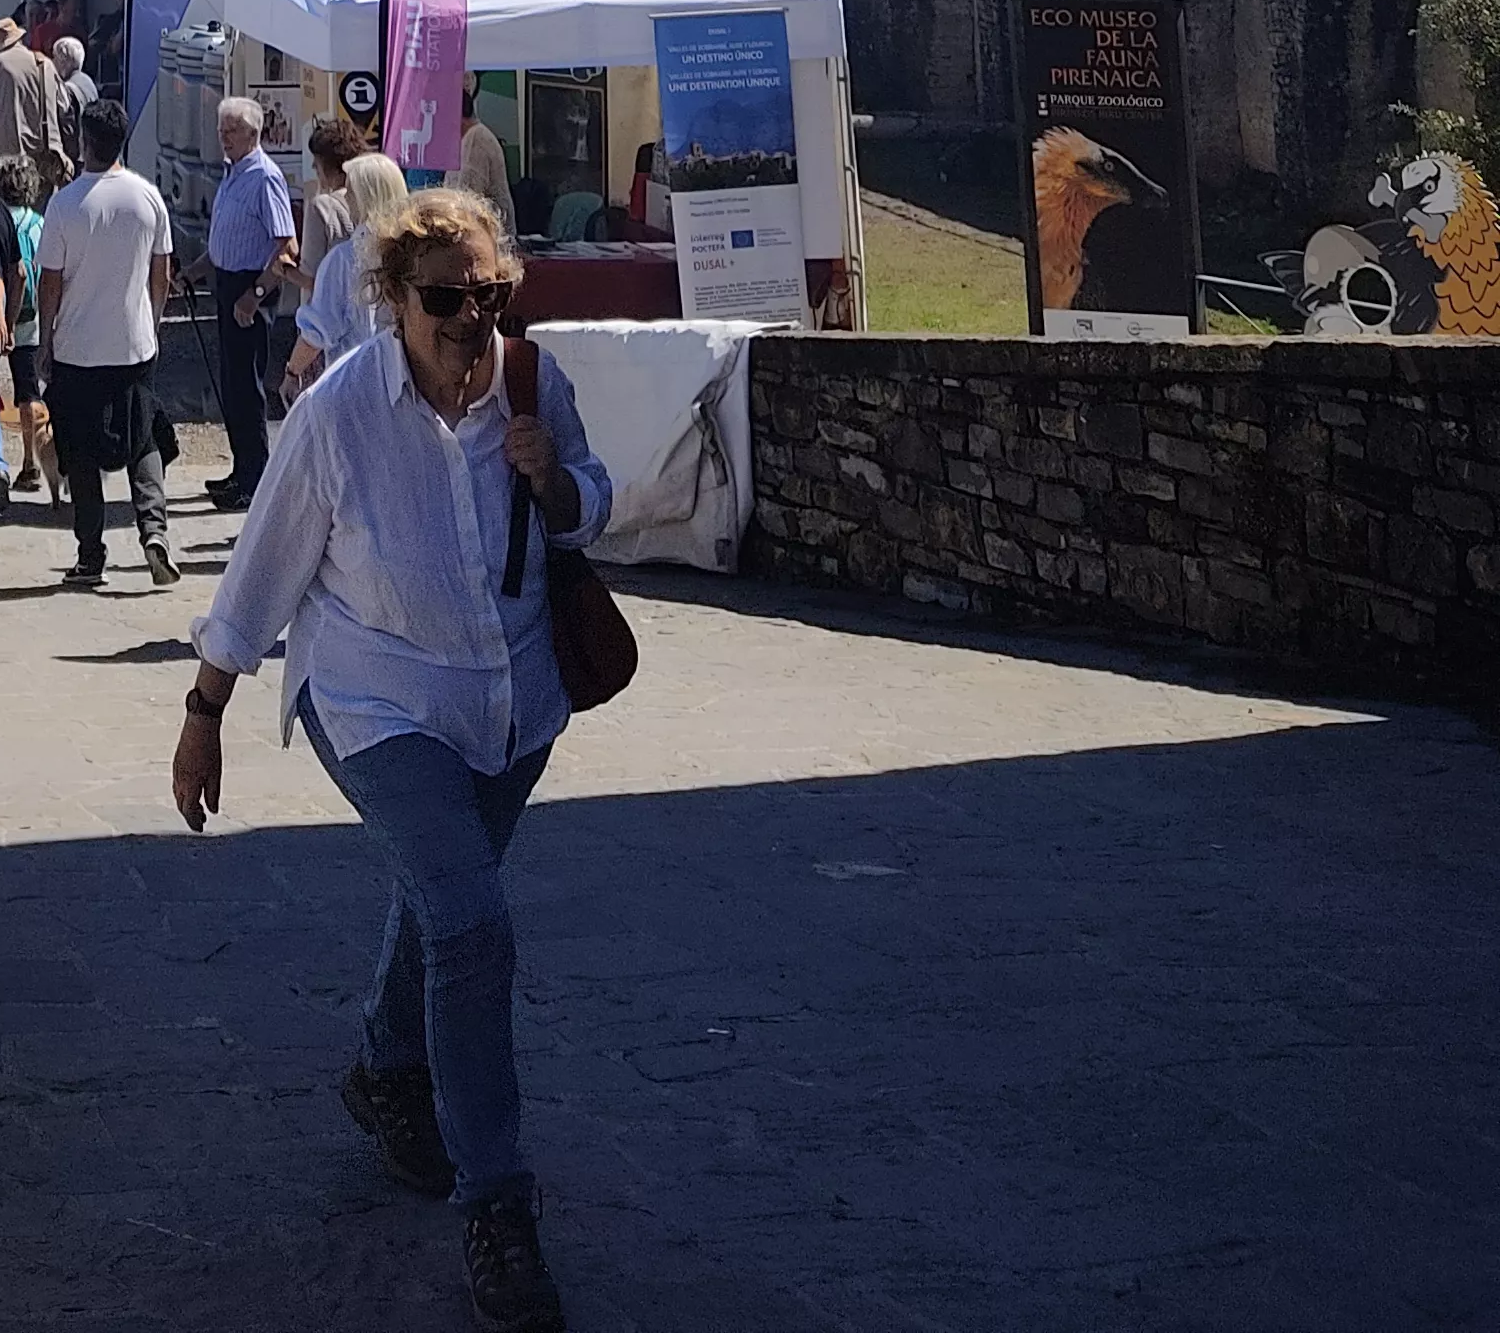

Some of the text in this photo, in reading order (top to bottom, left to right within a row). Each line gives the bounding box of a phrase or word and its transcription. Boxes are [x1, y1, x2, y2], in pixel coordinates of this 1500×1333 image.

[1030, 9, 1157, 28] ECO MUSEO
[426, 2, 441, 72] STATION
[1096, 30, 1158, 48] DE LA
[681, 50, 764, 64] UN DESTINO ÚNICO
[1086, 49, 1160, 68] FAUNA
[668, 77, 781, 93] UNE DESTINATION UNIQUE
[1051, 68, 1162, 88] PIRENAICA
[1050, 94, 1164, 107] PARQUE ZOOLÓGICO
[693, 259, 727, 271] DUSAL
